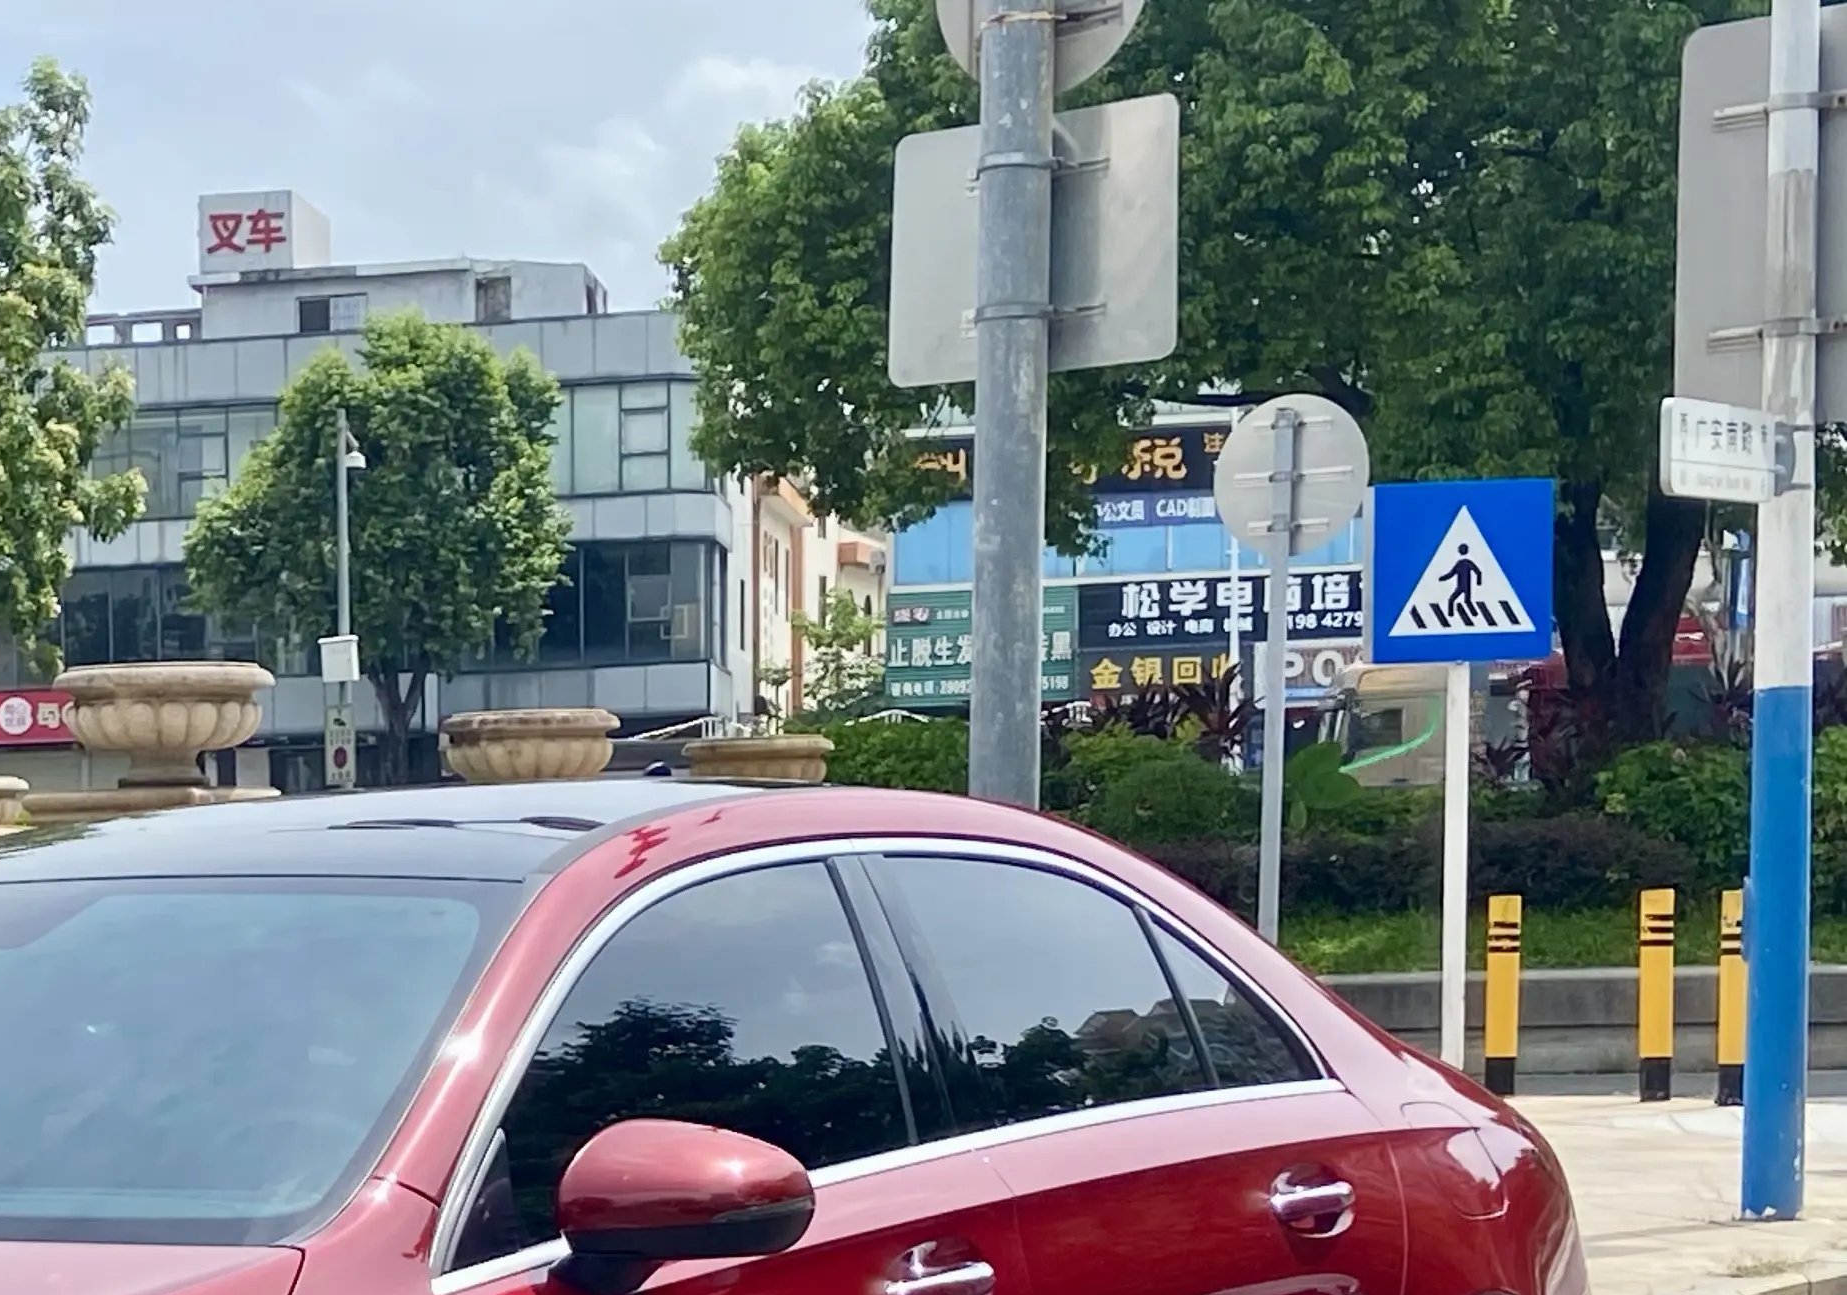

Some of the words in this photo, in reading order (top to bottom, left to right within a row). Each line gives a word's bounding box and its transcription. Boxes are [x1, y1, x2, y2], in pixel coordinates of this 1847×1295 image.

[207, 209, 287, 254] 叉车
[1121, 574, 1363, 619] 松学电脑培
